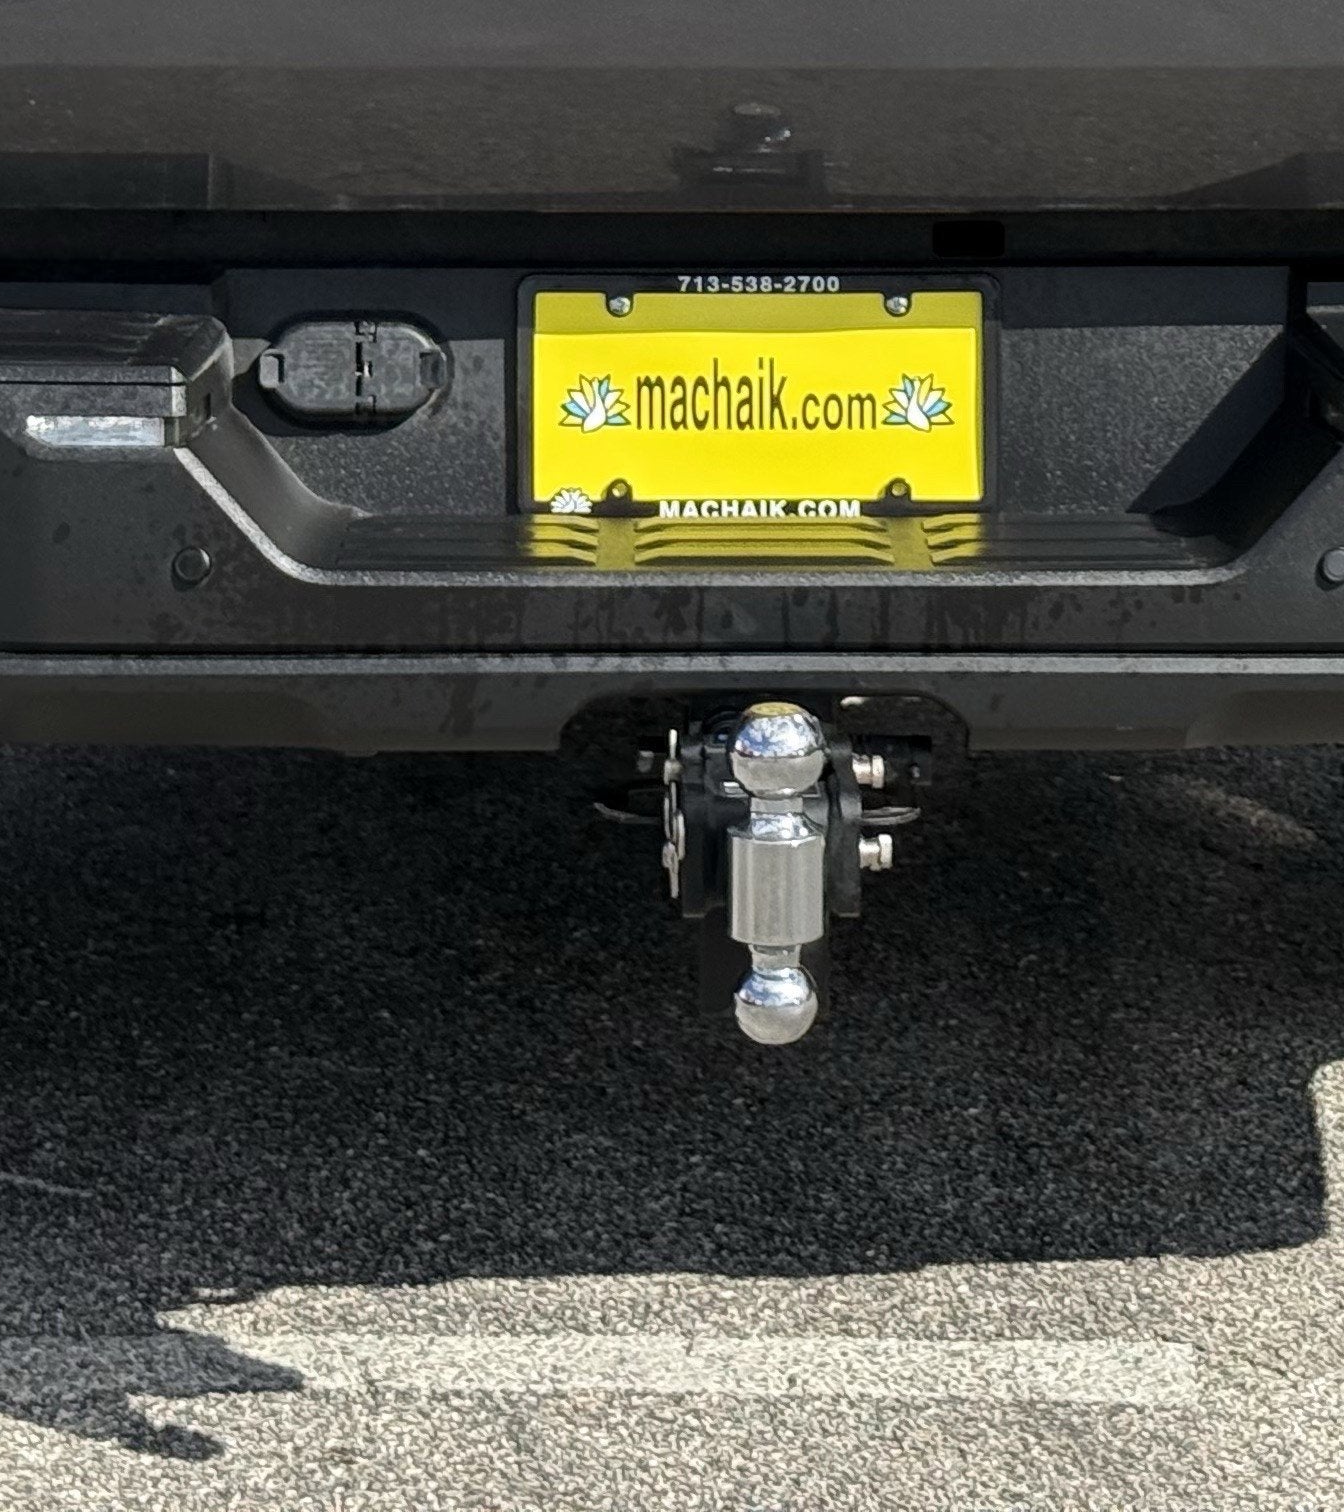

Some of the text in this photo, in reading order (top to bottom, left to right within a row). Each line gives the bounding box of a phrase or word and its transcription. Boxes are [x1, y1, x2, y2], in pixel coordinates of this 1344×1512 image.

[677, 275, 841, 293] 713-538-2700
[635, 357, 877, 430] machaik.com
[658, 499, 861, 519] MACHAIK.COM
